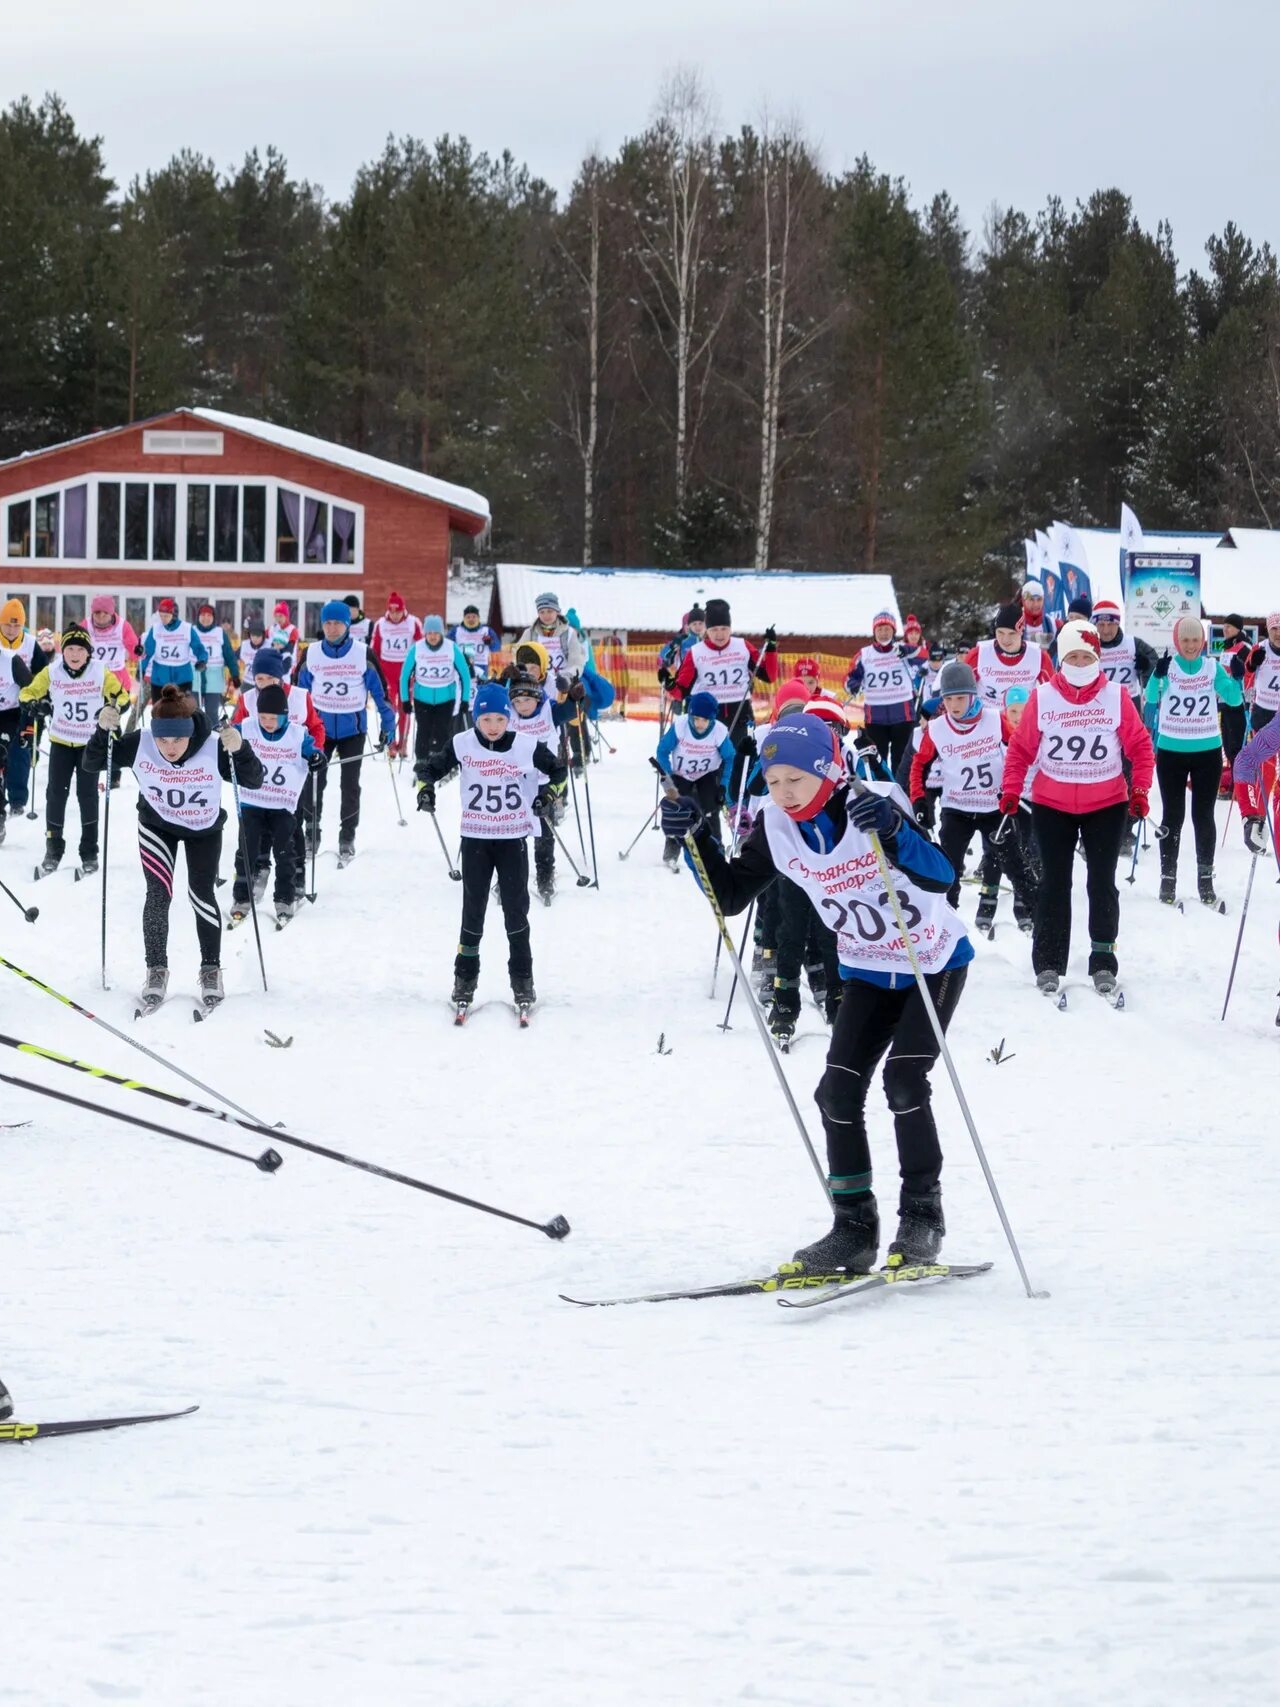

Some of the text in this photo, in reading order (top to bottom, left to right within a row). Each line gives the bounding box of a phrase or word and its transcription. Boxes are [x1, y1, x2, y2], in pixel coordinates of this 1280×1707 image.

[160, 646, 180, 658] 54
[386, 639, 408, 650] 141
[419, 667, 450, 679] 232
[704, 668, 743, 686] 312
[866, 670, 903, 688] 295
[63, 701, 89, 722] 35
[1168, 695, 1211, 717] 292
[1038, 708, 1105, 725] Устьянская
[1061, 717, 1113, 729] пятерочка
[941, 735, 994, 757] Устьянская
[1047, 734, 1108, 761] 296
[139, 761, 204, 774] Устьянская
[676, 756, 711, 776] 133
[960, 762, 994, 791] 25
[468, 783, 522, 813] 255
[462, 811, 517, 821] БИОТОПЛИВО
[821, 889, 922, 942] 203
